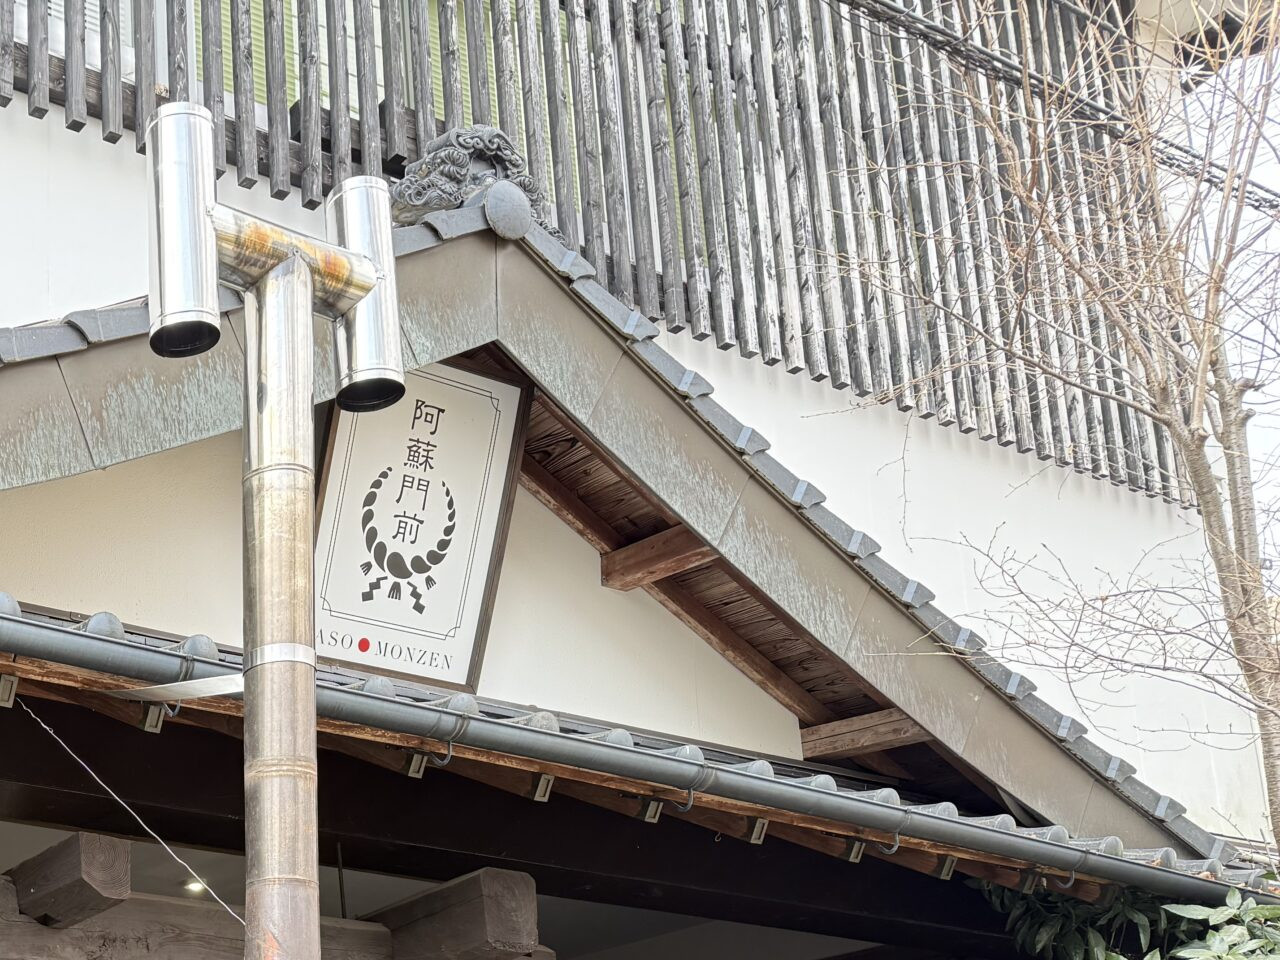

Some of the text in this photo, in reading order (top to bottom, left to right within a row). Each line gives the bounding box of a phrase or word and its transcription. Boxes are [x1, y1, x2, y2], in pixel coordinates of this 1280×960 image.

[391, 398, 446, 545] 阿蘇門前
[316, 628, 454, 671] ASO MONZEN
